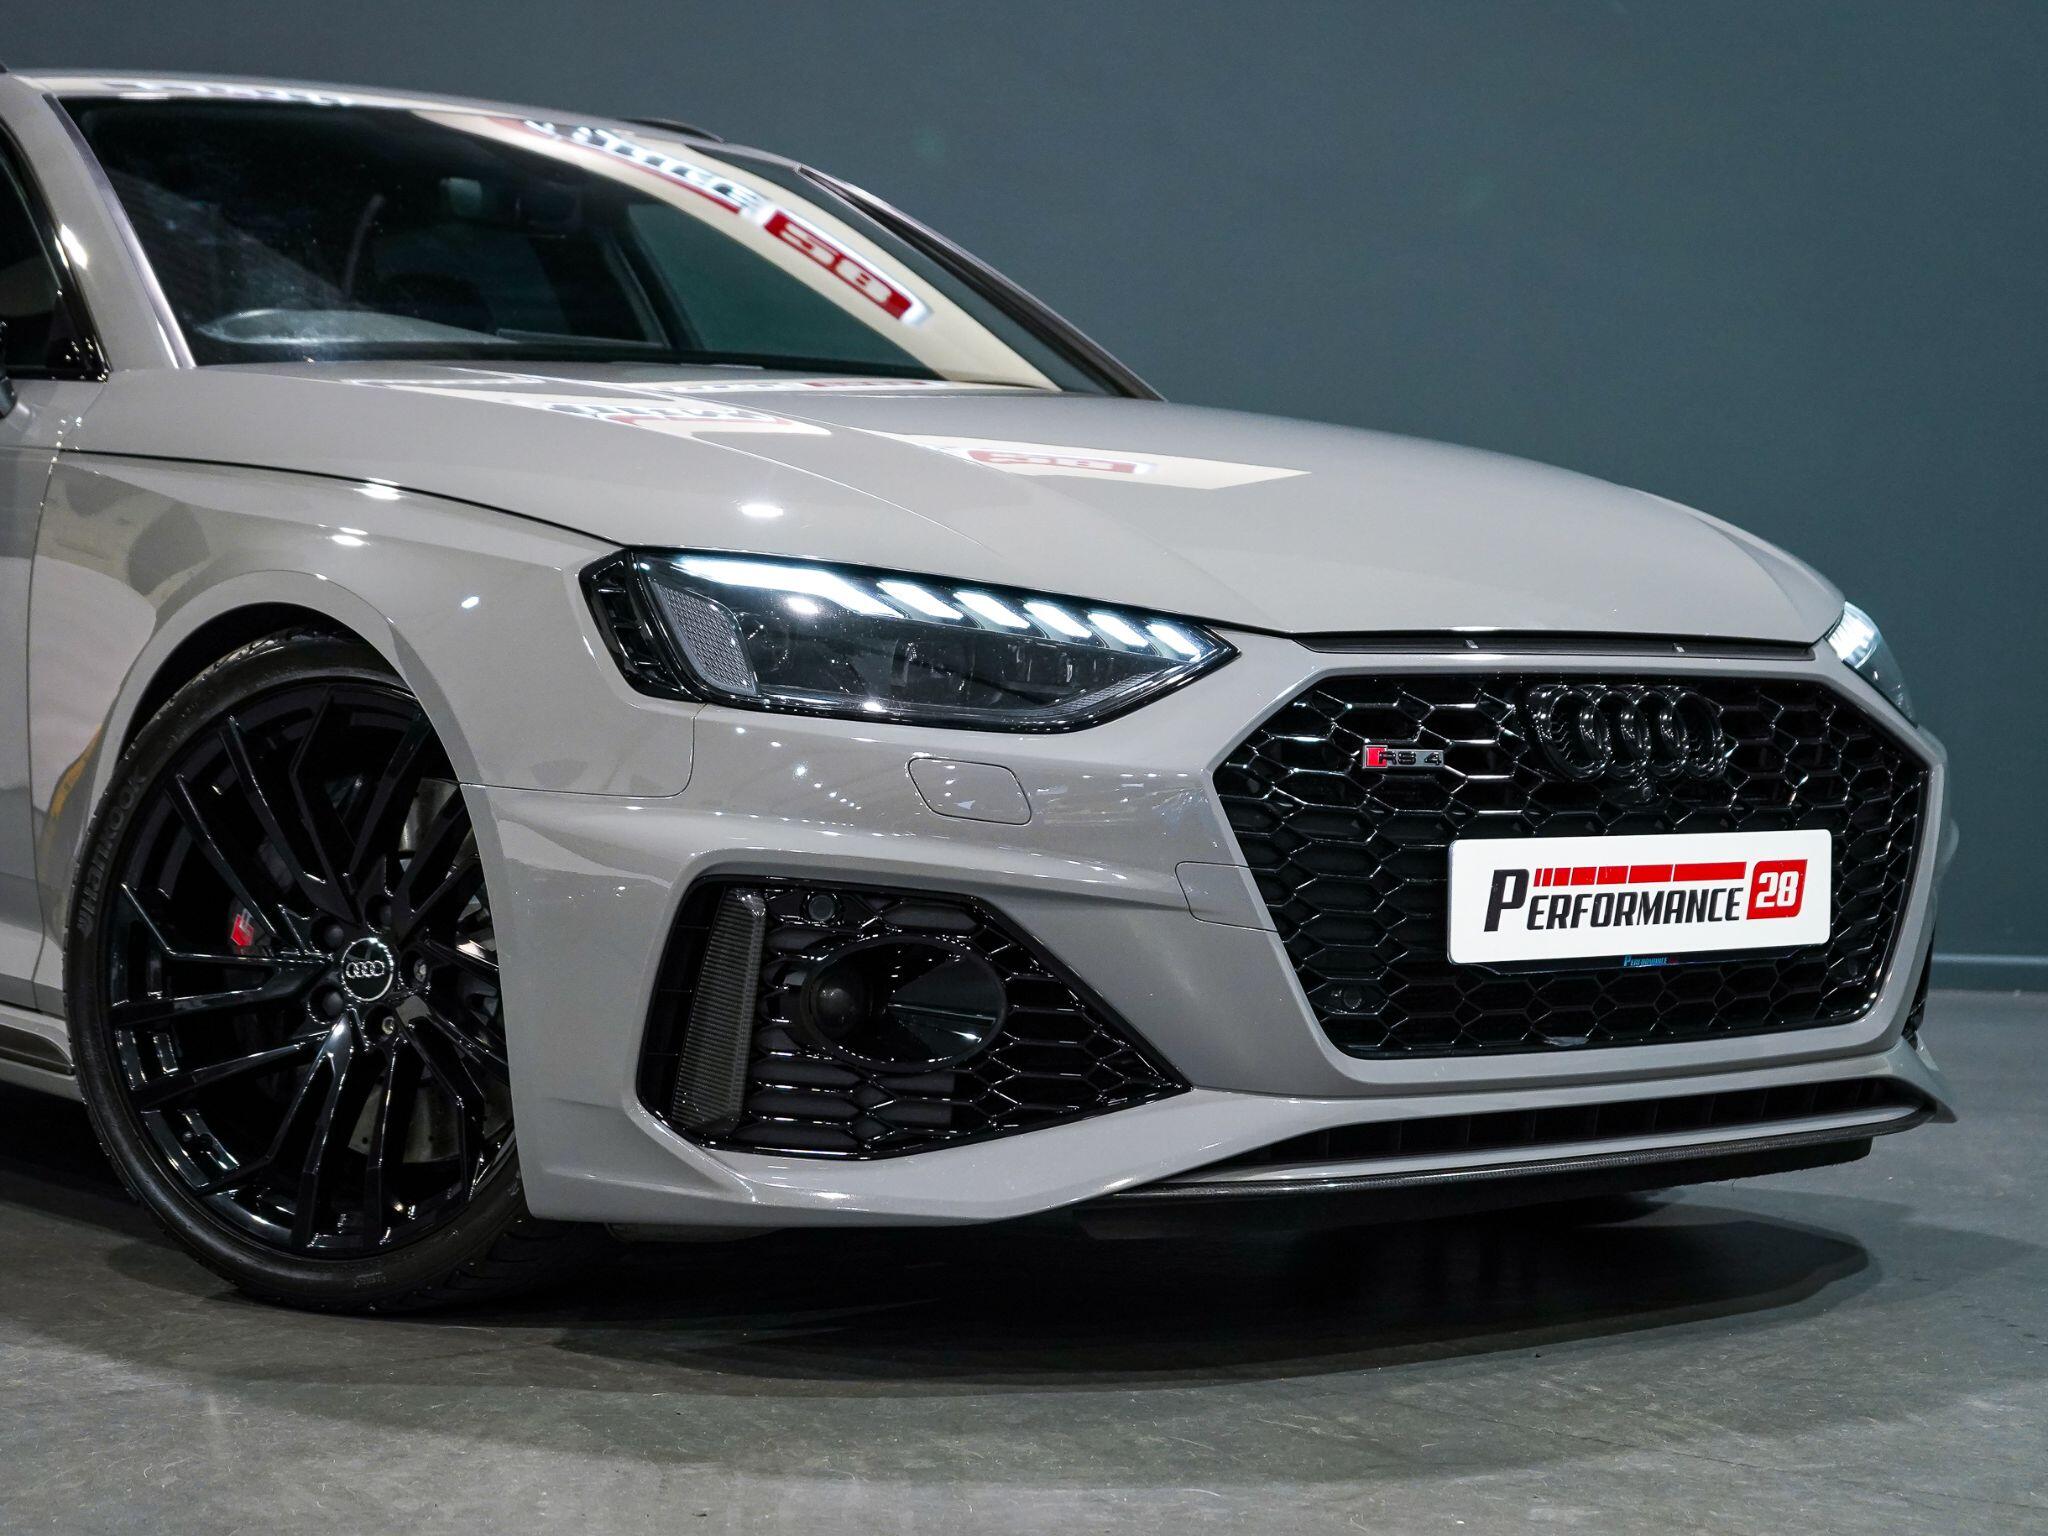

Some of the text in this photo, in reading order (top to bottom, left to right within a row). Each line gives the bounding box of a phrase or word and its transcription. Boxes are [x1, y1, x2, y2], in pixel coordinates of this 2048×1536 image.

[1378, 750, 1442, 765] RS 4
[1484, 868, 1799, 932] PERFORMANCE 28
